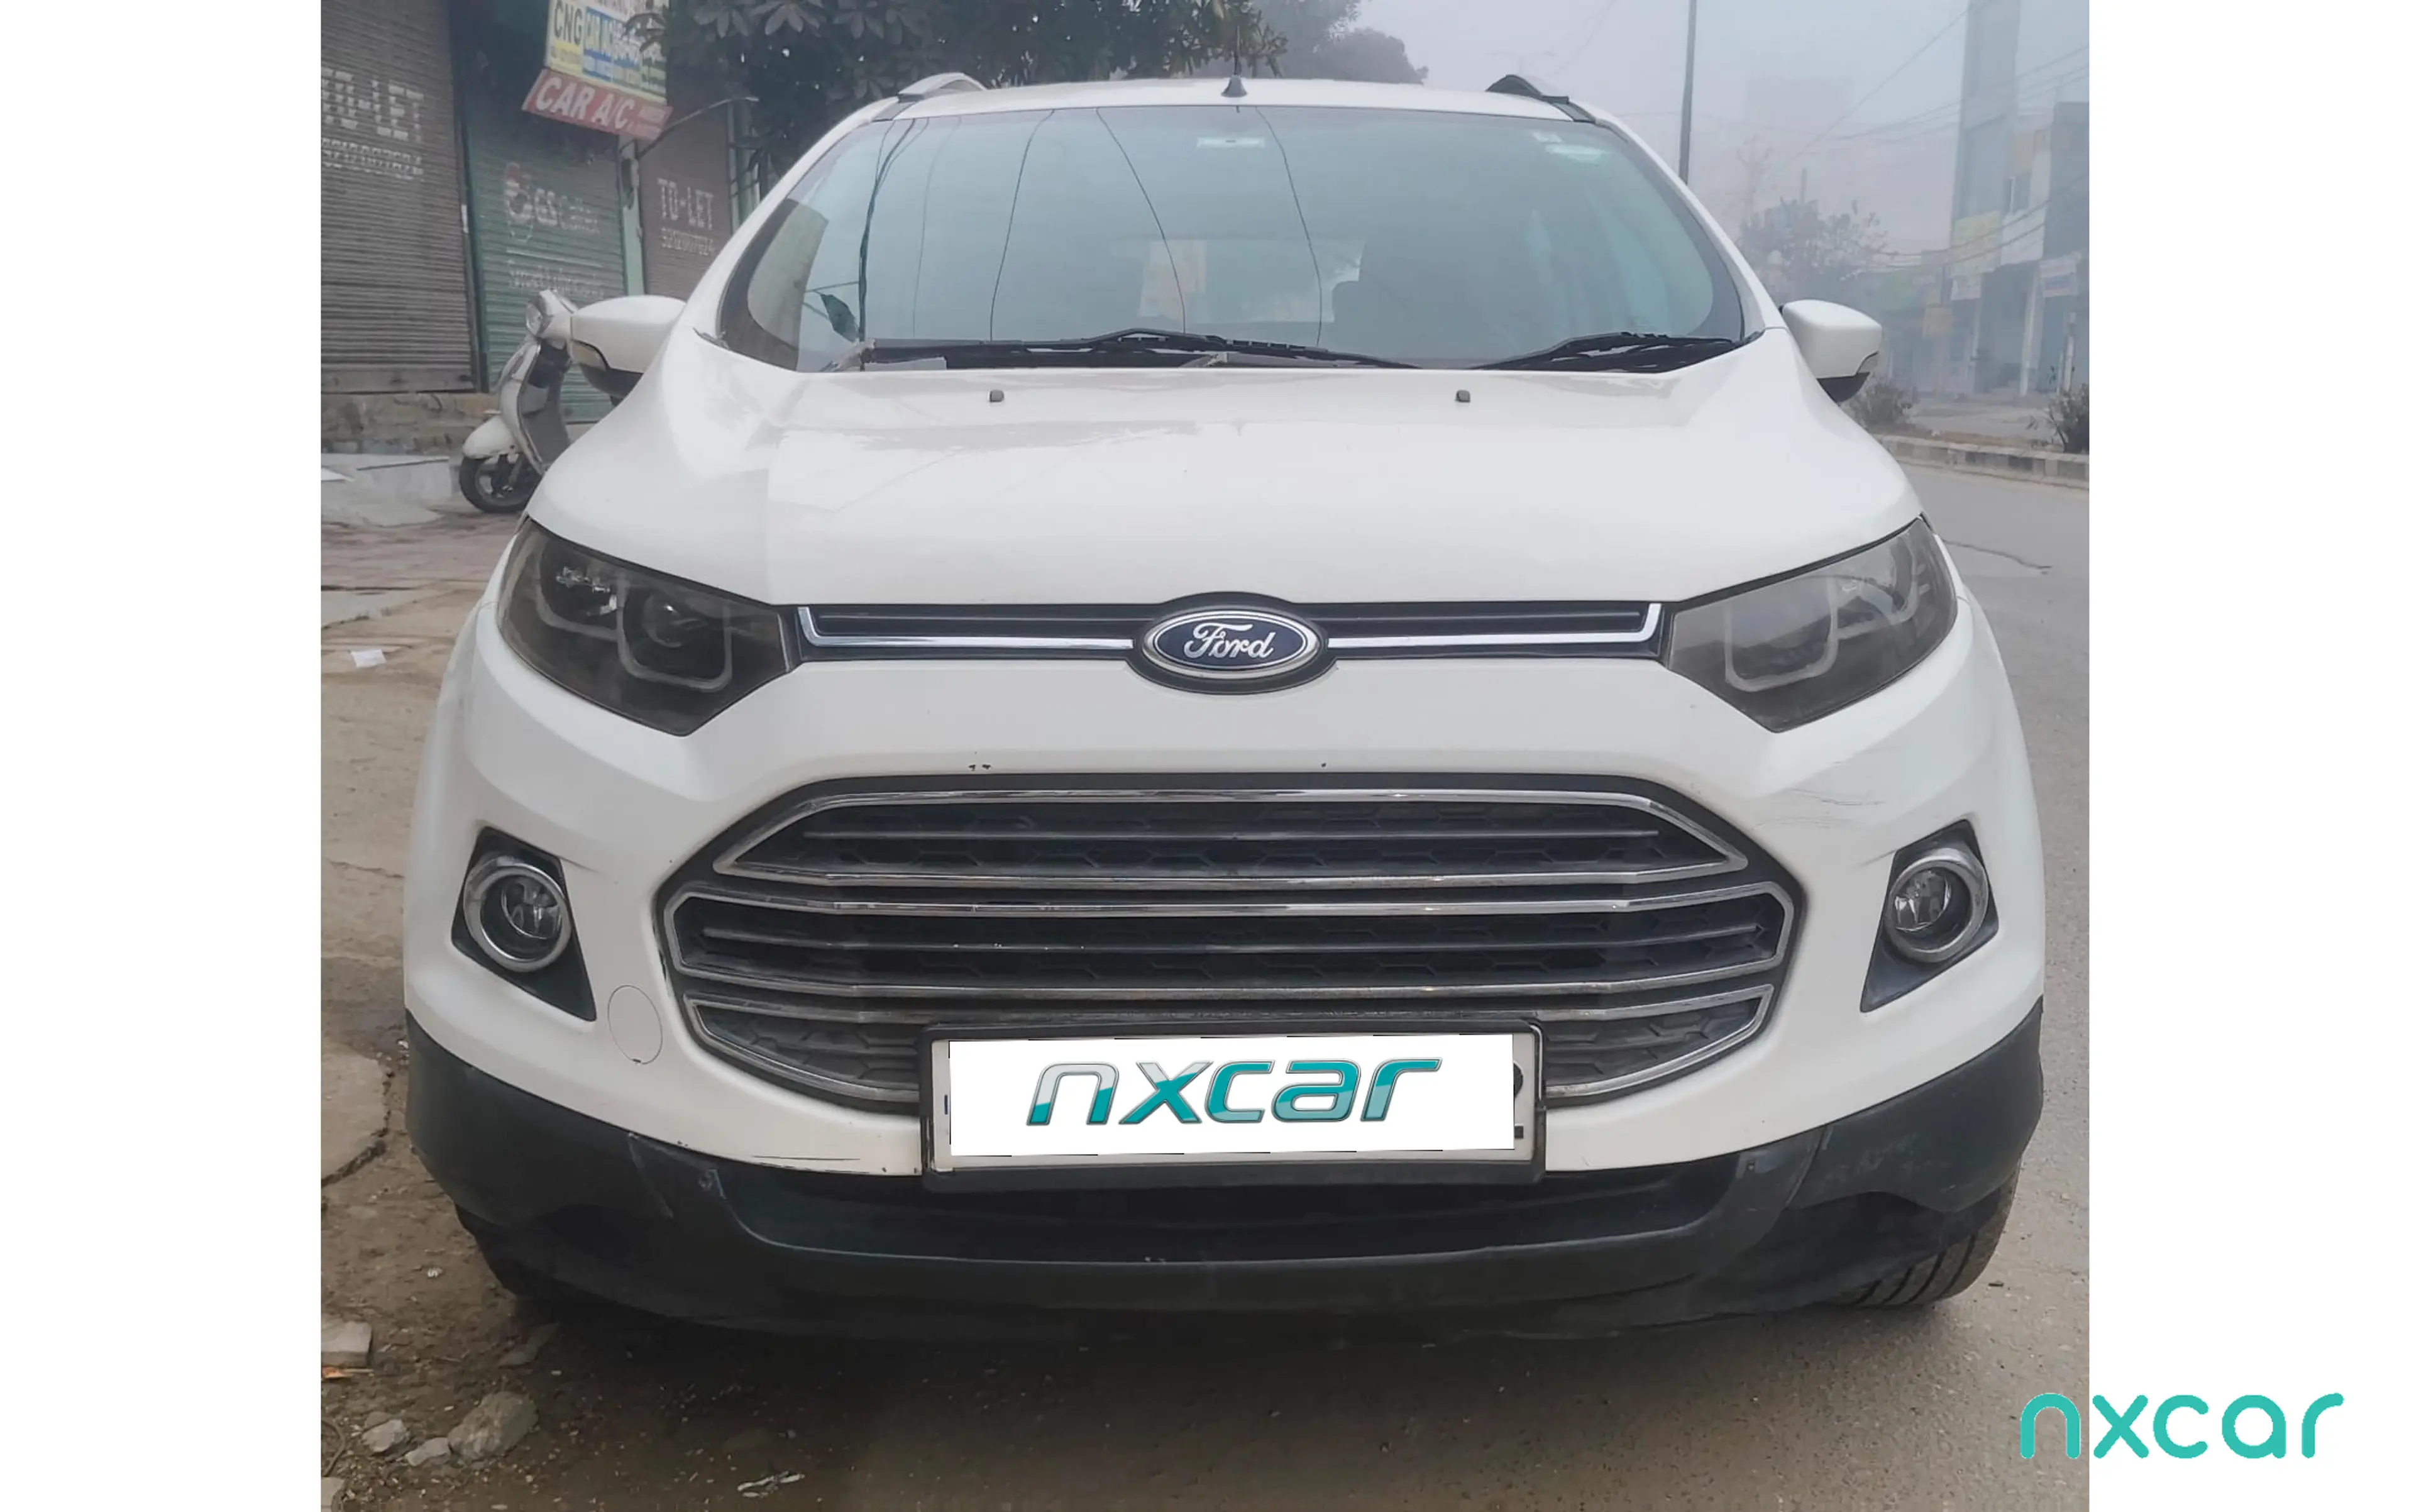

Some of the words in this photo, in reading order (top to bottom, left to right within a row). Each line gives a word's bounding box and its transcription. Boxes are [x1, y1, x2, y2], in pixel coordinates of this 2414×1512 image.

[554, 1, 583, 46] CNG
[536, 76, 596, 120] CAR
[591, 92, 635, 130] A/C
[657, 177, 714, 231] TO-LET
[1183, 622, 1276, 658] Ford
